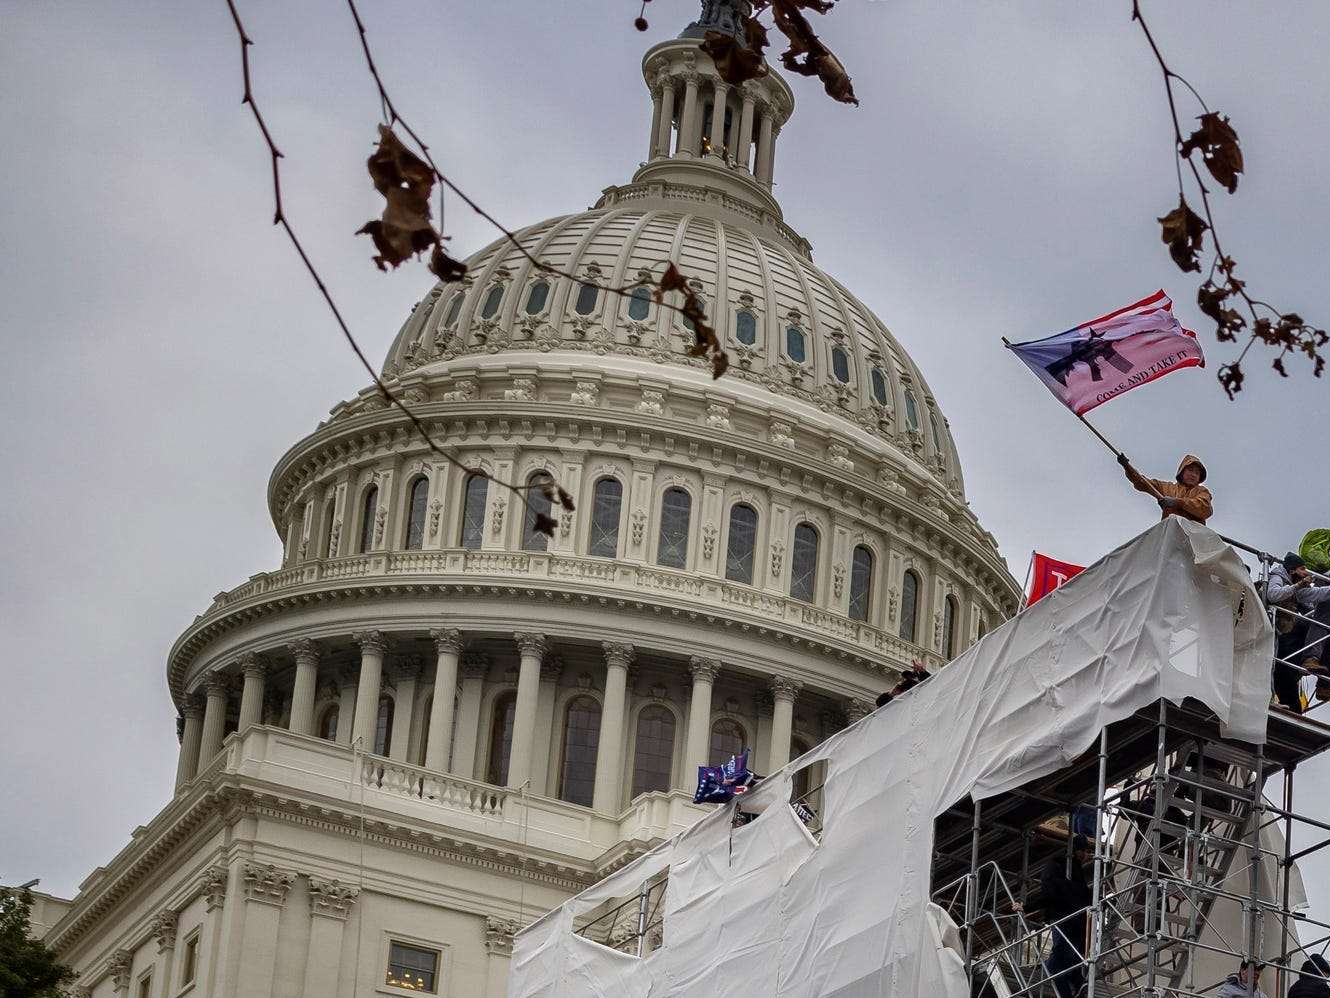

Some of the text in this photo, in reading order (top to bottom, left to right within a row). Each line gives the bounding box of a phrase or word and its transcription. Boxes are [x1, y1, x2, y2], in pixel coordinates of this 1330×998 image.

[1096, 349, 1189, 402] COME AND TAKE IT
